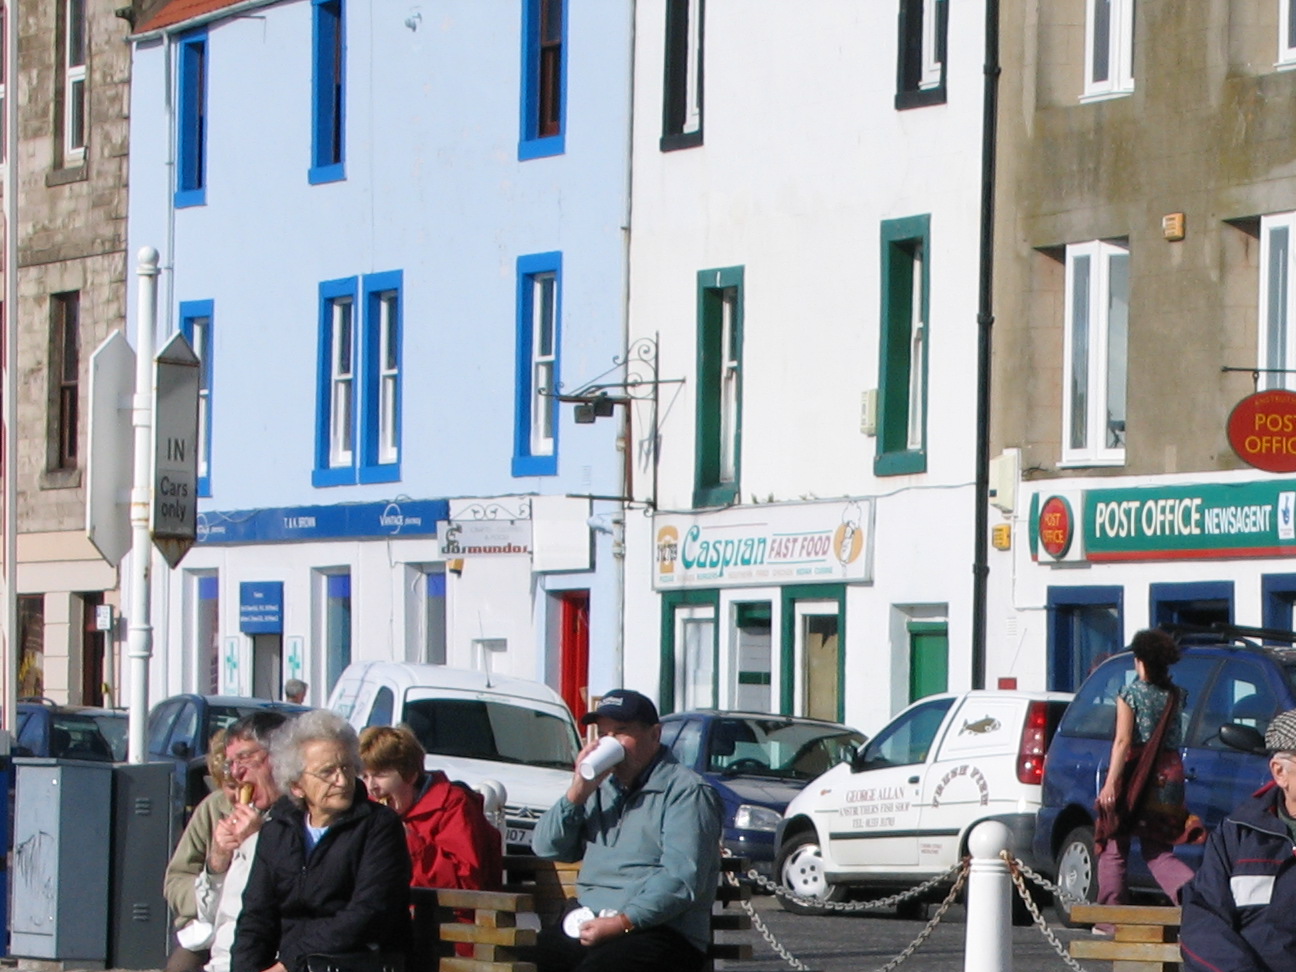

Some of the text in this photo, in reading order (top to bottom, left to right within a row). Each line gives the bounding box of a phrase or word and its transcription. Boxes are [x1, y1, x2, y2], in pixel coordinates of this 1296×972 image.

[167, 438, 185, 461] IN
[160, 476, 188, 496] Cars
[161, 499, 186, 522] only
[1096, 498, 1272, 538] POST OFFICE NEWSAGENT
[682, 524, 831, 577] Caspian FAST FOOD
[846, 786, 905, 803] GEORGE ALLAN
[932, 765, 988, 808] FRESH FISH
[880, 802, 894, 813] FISH
[895, 801, 910, 812] SHOP
